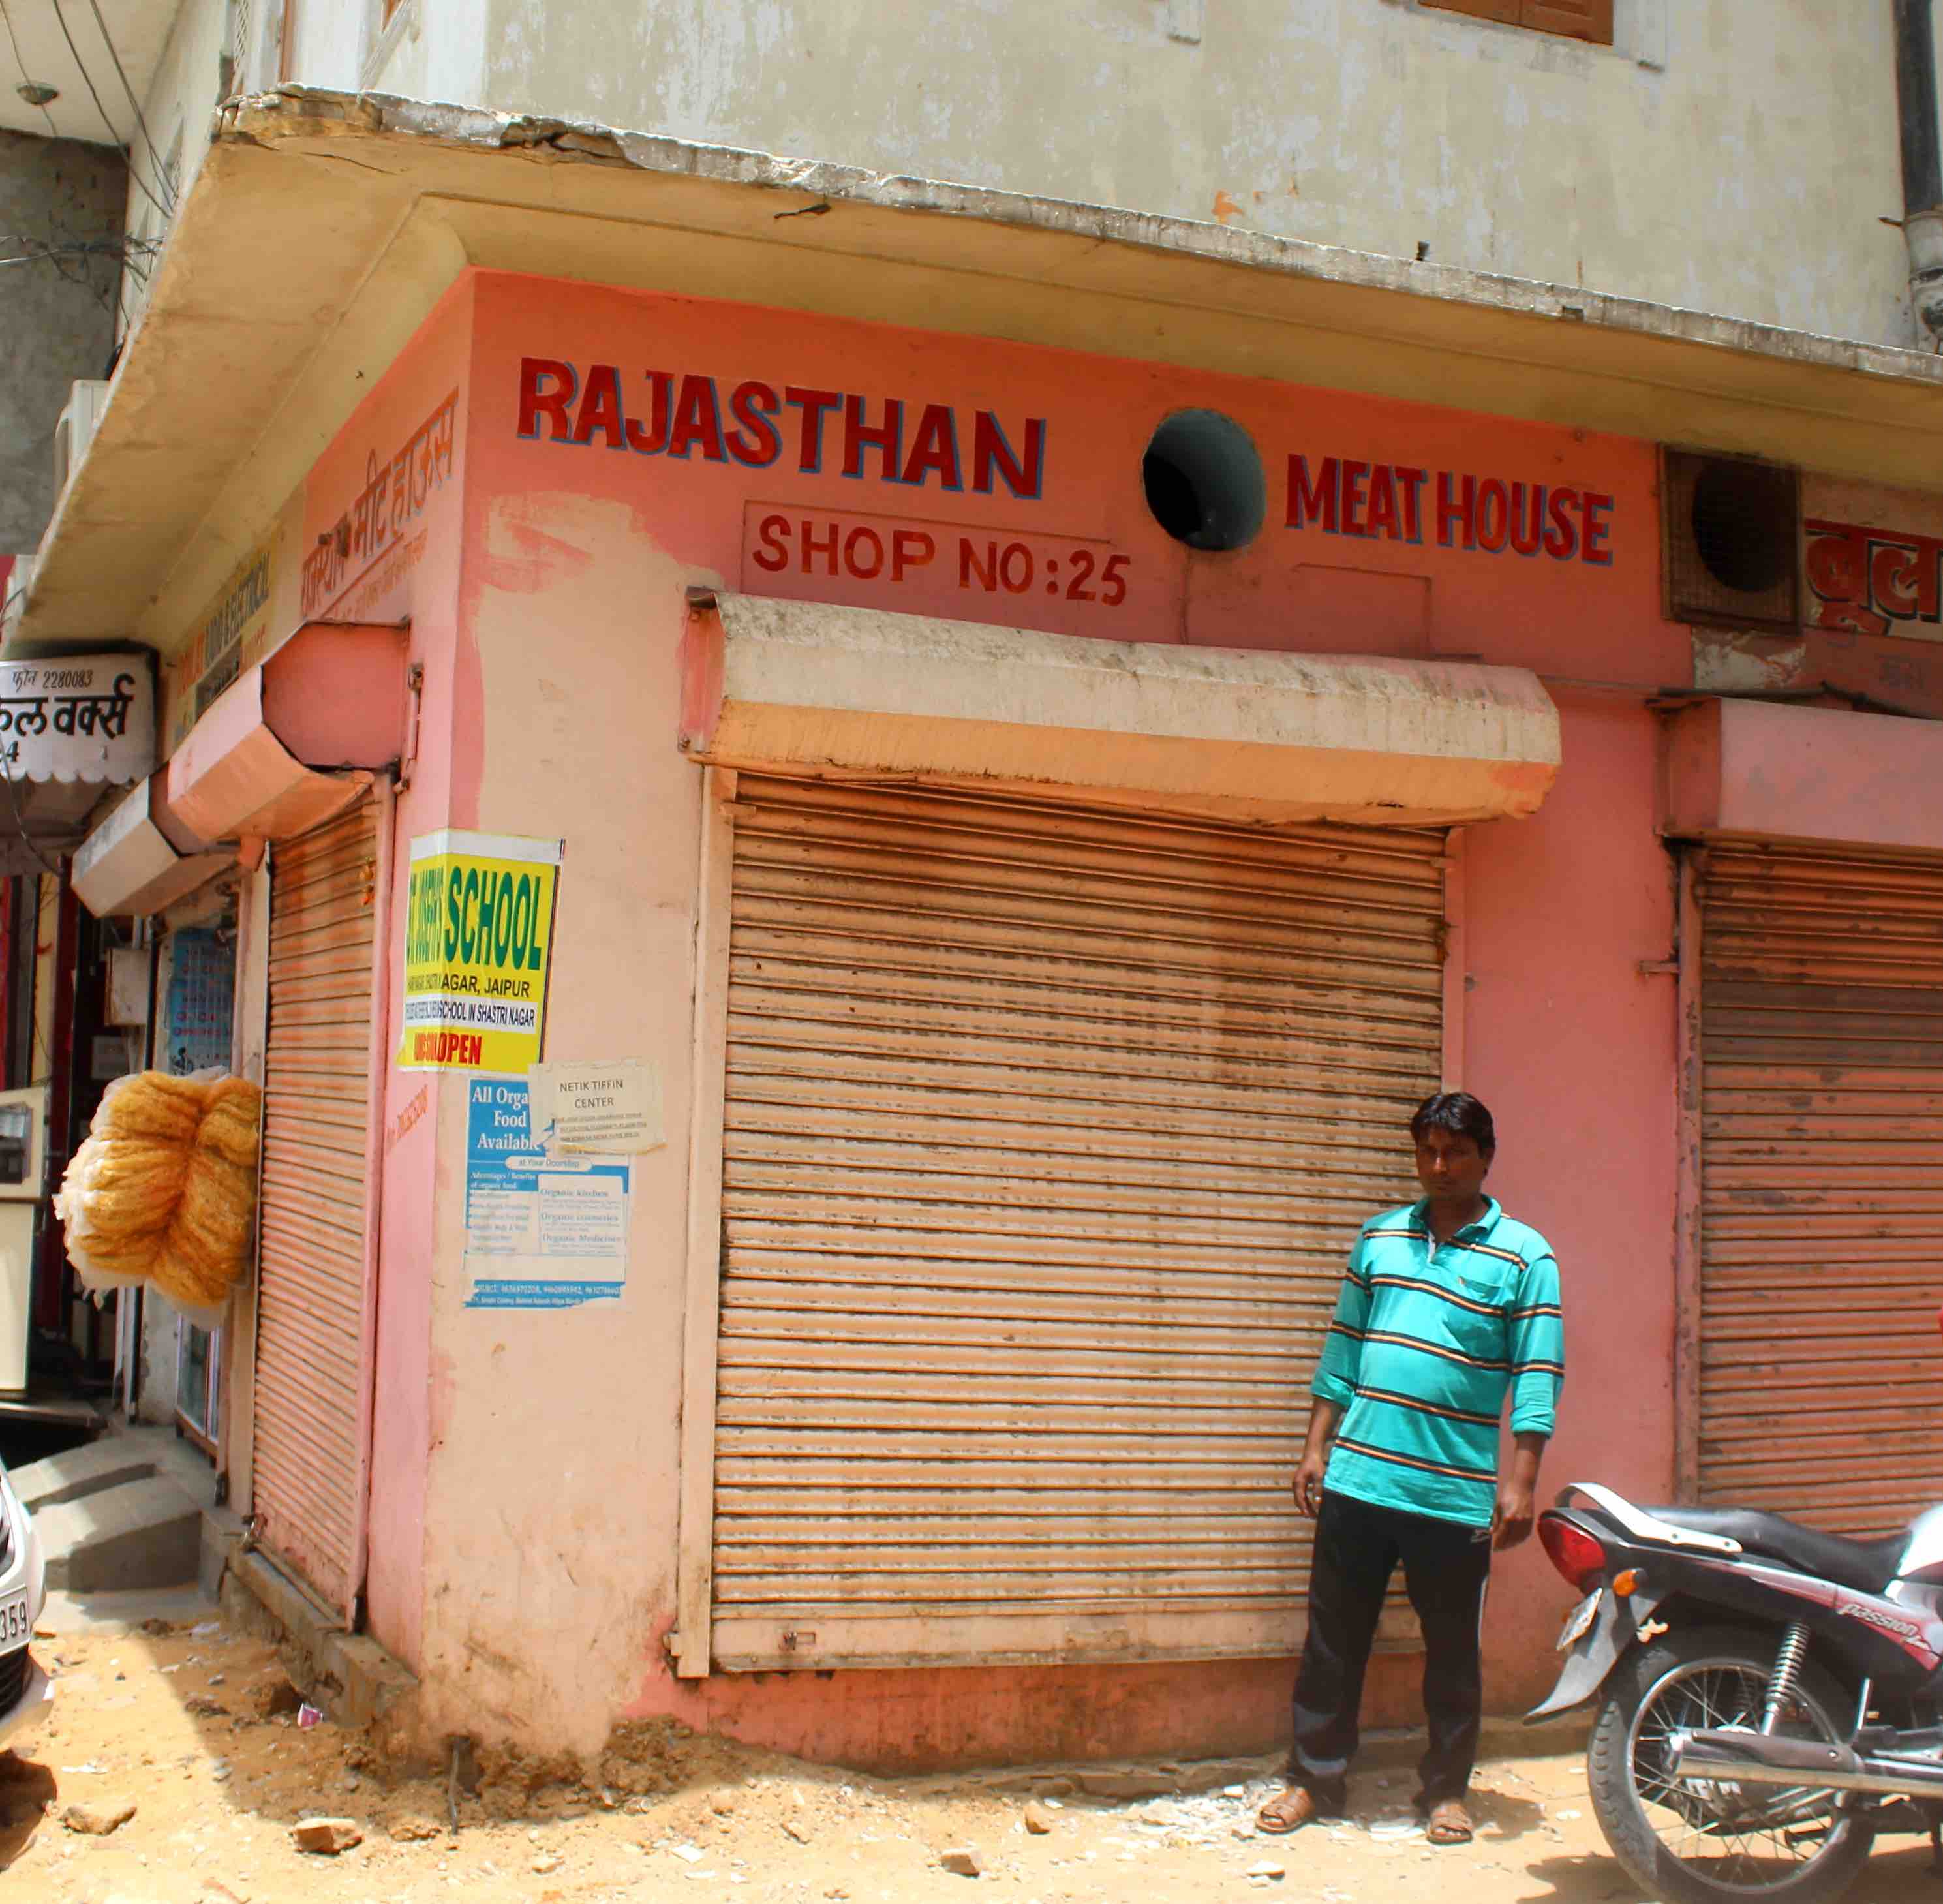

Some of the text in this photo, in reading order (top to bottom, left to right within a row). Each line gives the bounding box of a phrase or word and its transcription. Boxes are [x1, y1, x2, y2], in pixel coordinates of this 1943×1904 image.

[517, 356, 1046, 500] RAJASTHAN
[1285, 453, 1614, 566] MEAT HOUSE
[751, 514, 1131, 607] SHOP NO:25
[42, 668, 93, 690] 2280083
[443, 865, 542, 970] SCHOOL
[483, 977, 530, 998] JAIPUR
[438, 1000, 467, 1021] SCHOOL
[467, 1002, 476, 1022] IN
[476, 1002, 508, 1025] SHASTRI
[508, 1007, 535, 1028] NAGAR
[437, 1032, 483, 1066] OPEN
[472, 1085, 528, 1111] All Orga
[559, 1080, 589, 1092] NETIK
[574, 1097, 615, 1109] CENTER
[493, 1110, 527, 1128] Food
